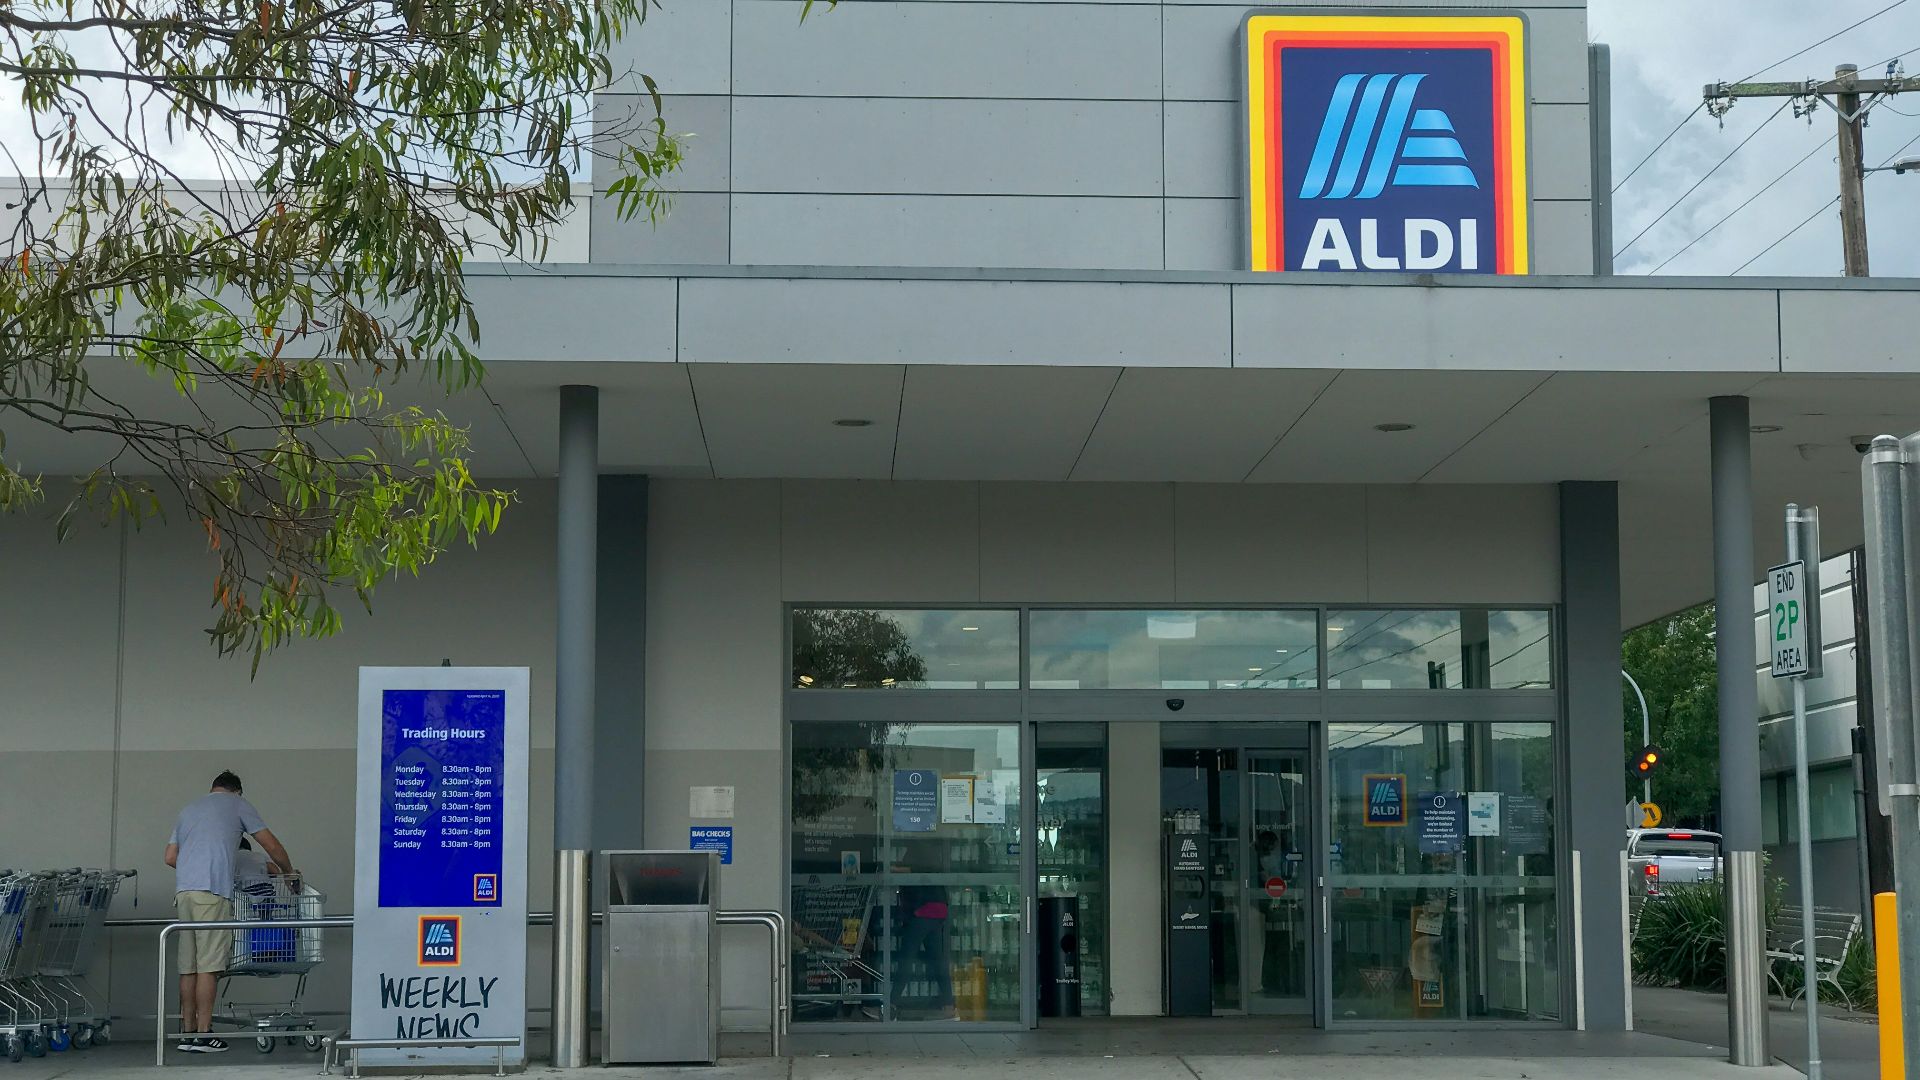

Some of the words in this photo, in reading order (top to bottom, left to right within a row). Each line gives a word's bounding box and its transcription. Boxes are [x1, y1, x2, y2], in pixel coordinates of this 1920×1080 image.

[1301, 218, 1477, 270] ALDI
[1777, 571, 1795, 593] END
[1775, 600, 1799, 641] 2P
[1777, 648, 1802, 670] AREA
[402, 728, 448, 740] Trading
[451, 728, 486, 739] Hours
[395, 766, 424, 774] Monday
[442, 765, 469, 773] 8.30am
[474, 765, 492, 774] 8pm
[395, 778, 426, 787] Tuesday
[474, 778, 492, 787] 8pm
[395, 791, 437, 799] Wednesday
[442, 790, 469, 798] 8.30am
[474, 790, 491, 799] 8pm
[395, 803, 428, 812] Thursday
[474, 803, 491, 812] 8pm
[1371, 805, 1400, 816] ALDI
[394, 816, 417, 824] Friday
[441, 815, 468, 823] 8.30am
[474, 815, 491, 824] 8pm
[394, 828, 426, 837] Saturday
[473, 828, 491, 837] 8pm
[393, 841, 421, 849] Sunday
[441, 840, 468, 848] 8.30am
[473, 840, 491, 849] 8pm
[425, 947, 454, 956] ALDI
[380, 973, 498, 1009] WEEKLY
[397, 1012, 479, 1050] NEWS
